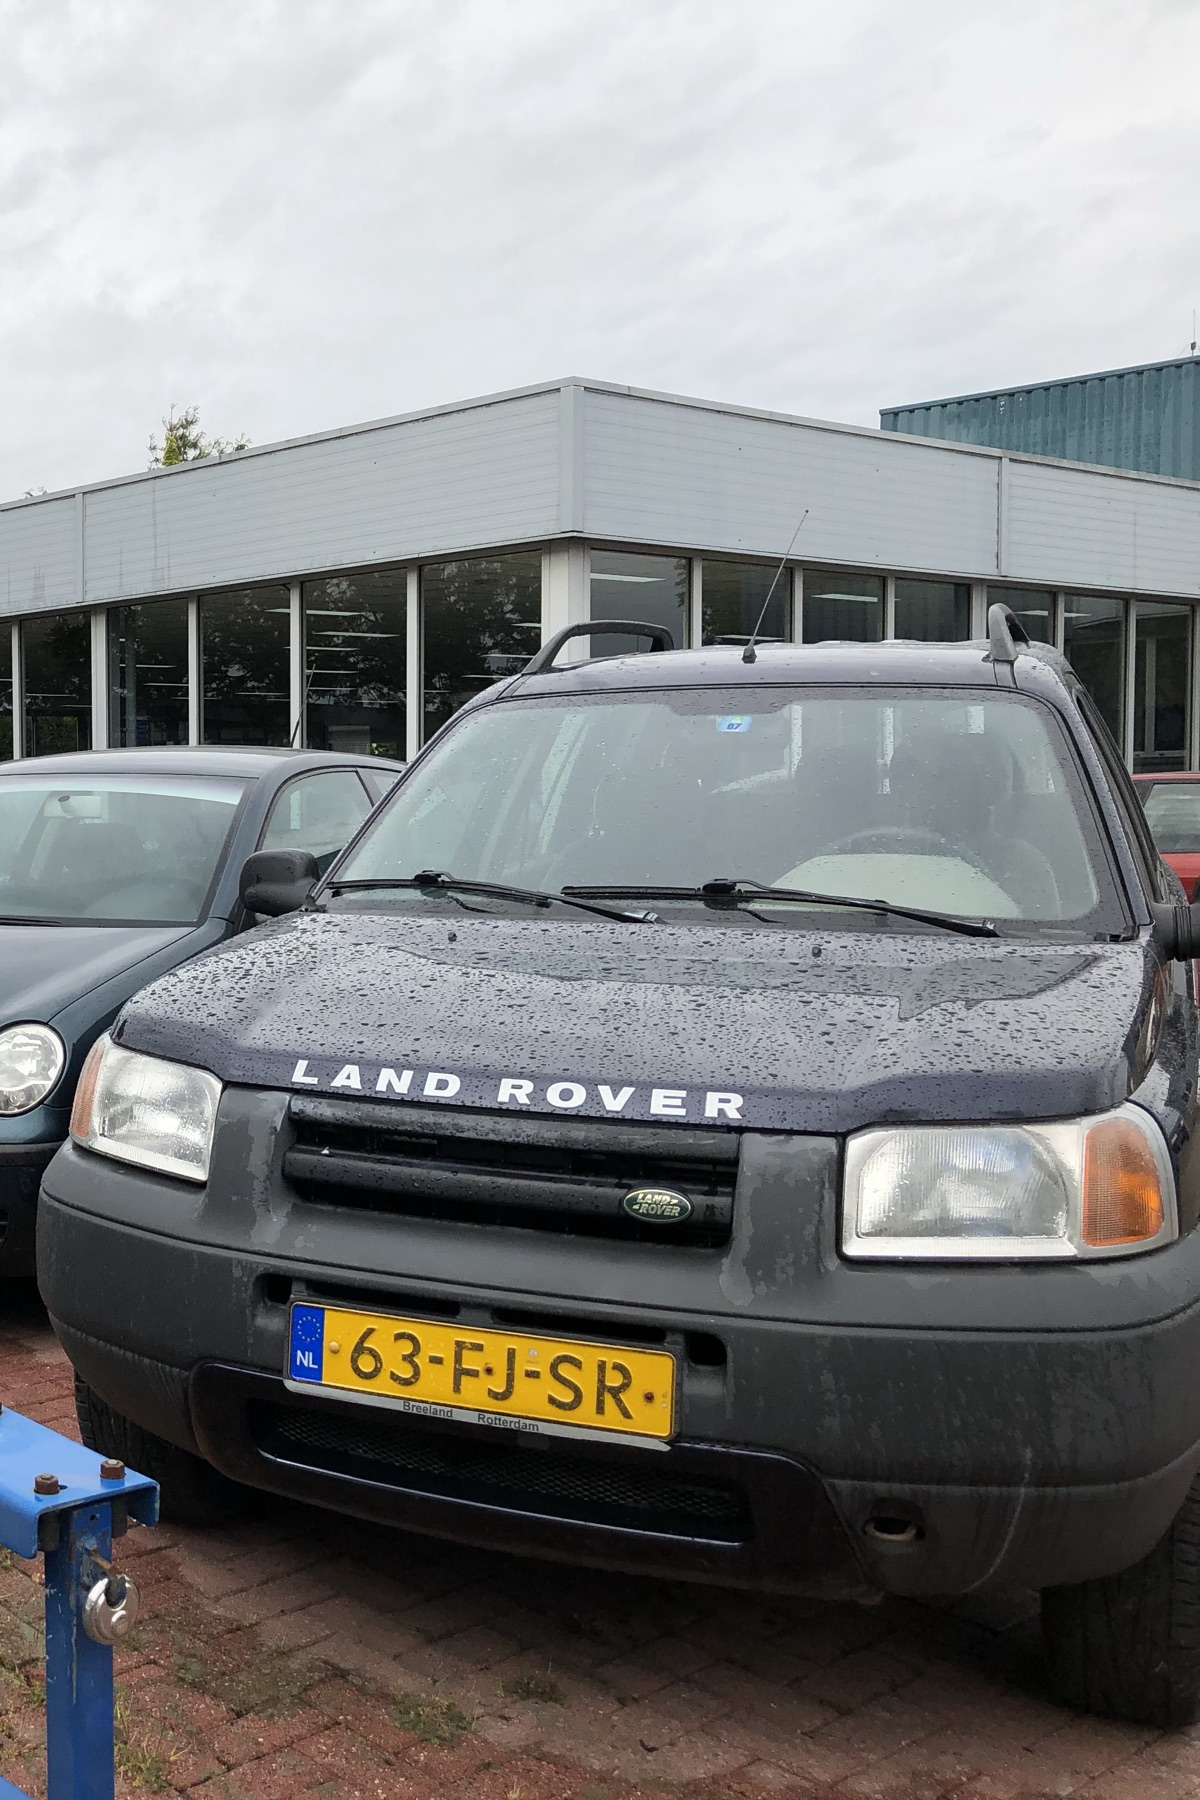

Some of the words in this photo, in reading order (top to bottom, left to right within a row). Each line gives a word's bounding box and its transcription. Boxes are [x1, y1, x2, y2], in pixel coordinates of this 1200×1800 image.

[291, 1059, 461, 1098] LAND
[496, 1077, 746, 1119] ROVER
[636, 1193, 671, 1205] LAND
[638, 1203, 681, 1217] ROVER
[296, 1349, 318, 1369] NL
[349, 1326, 634, 1420] 63-FJ-SR
[402, 1400, 454, 1418] Breeland
[477, 1413, 541, 1432] Rotterdam
